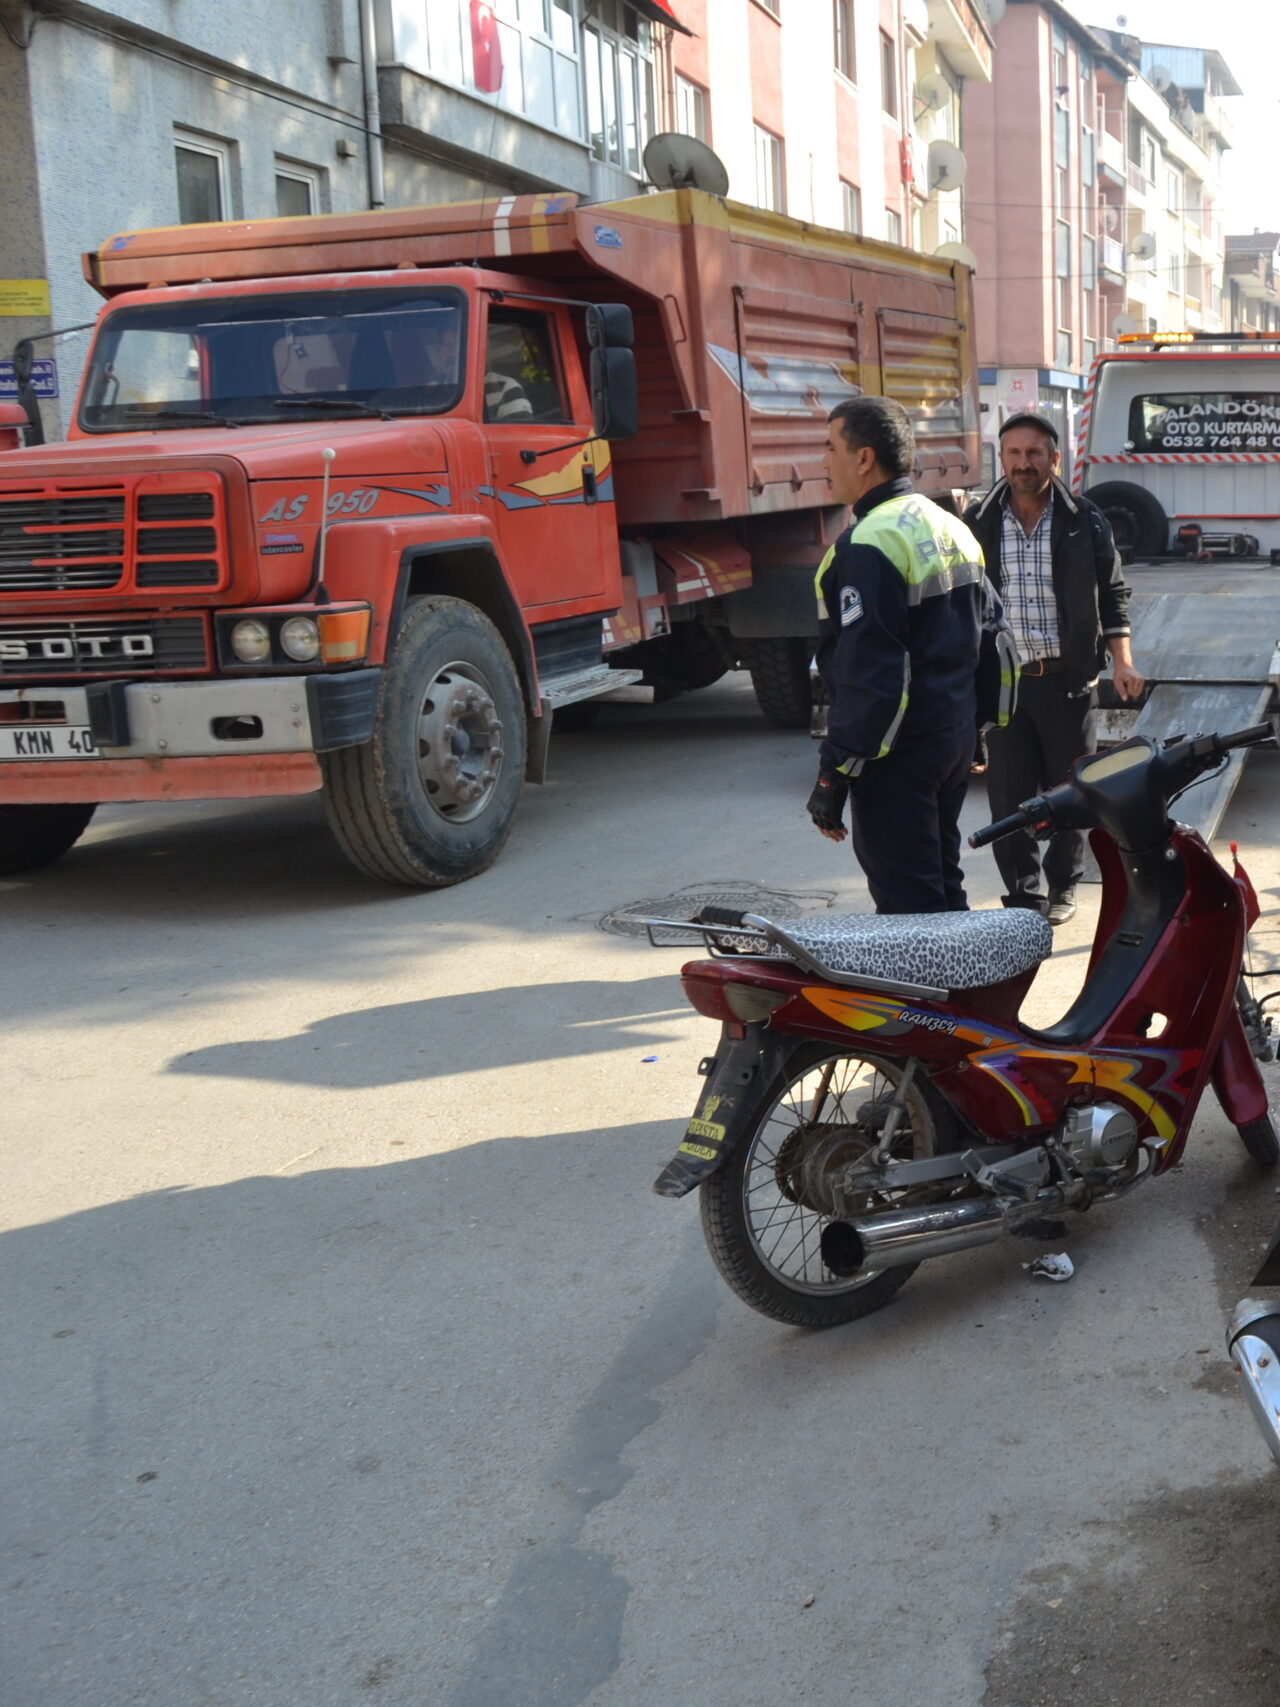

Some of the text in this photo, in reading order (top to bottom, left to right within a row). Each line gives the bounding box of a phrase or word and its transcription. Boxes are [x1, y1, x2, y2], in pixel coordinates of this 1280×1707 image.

[1166, 421, 1200, 434] OTO
[1162, 436, 1204, 447] 0532
[1209, 436, 1242, 447] 764
[1246, 436, 1267, 447] 48
[258, 487, 380, 523] AS 950
[13, 730, 54, 754] KMN
[898, 1010, 958, 1036] RAMZEY
